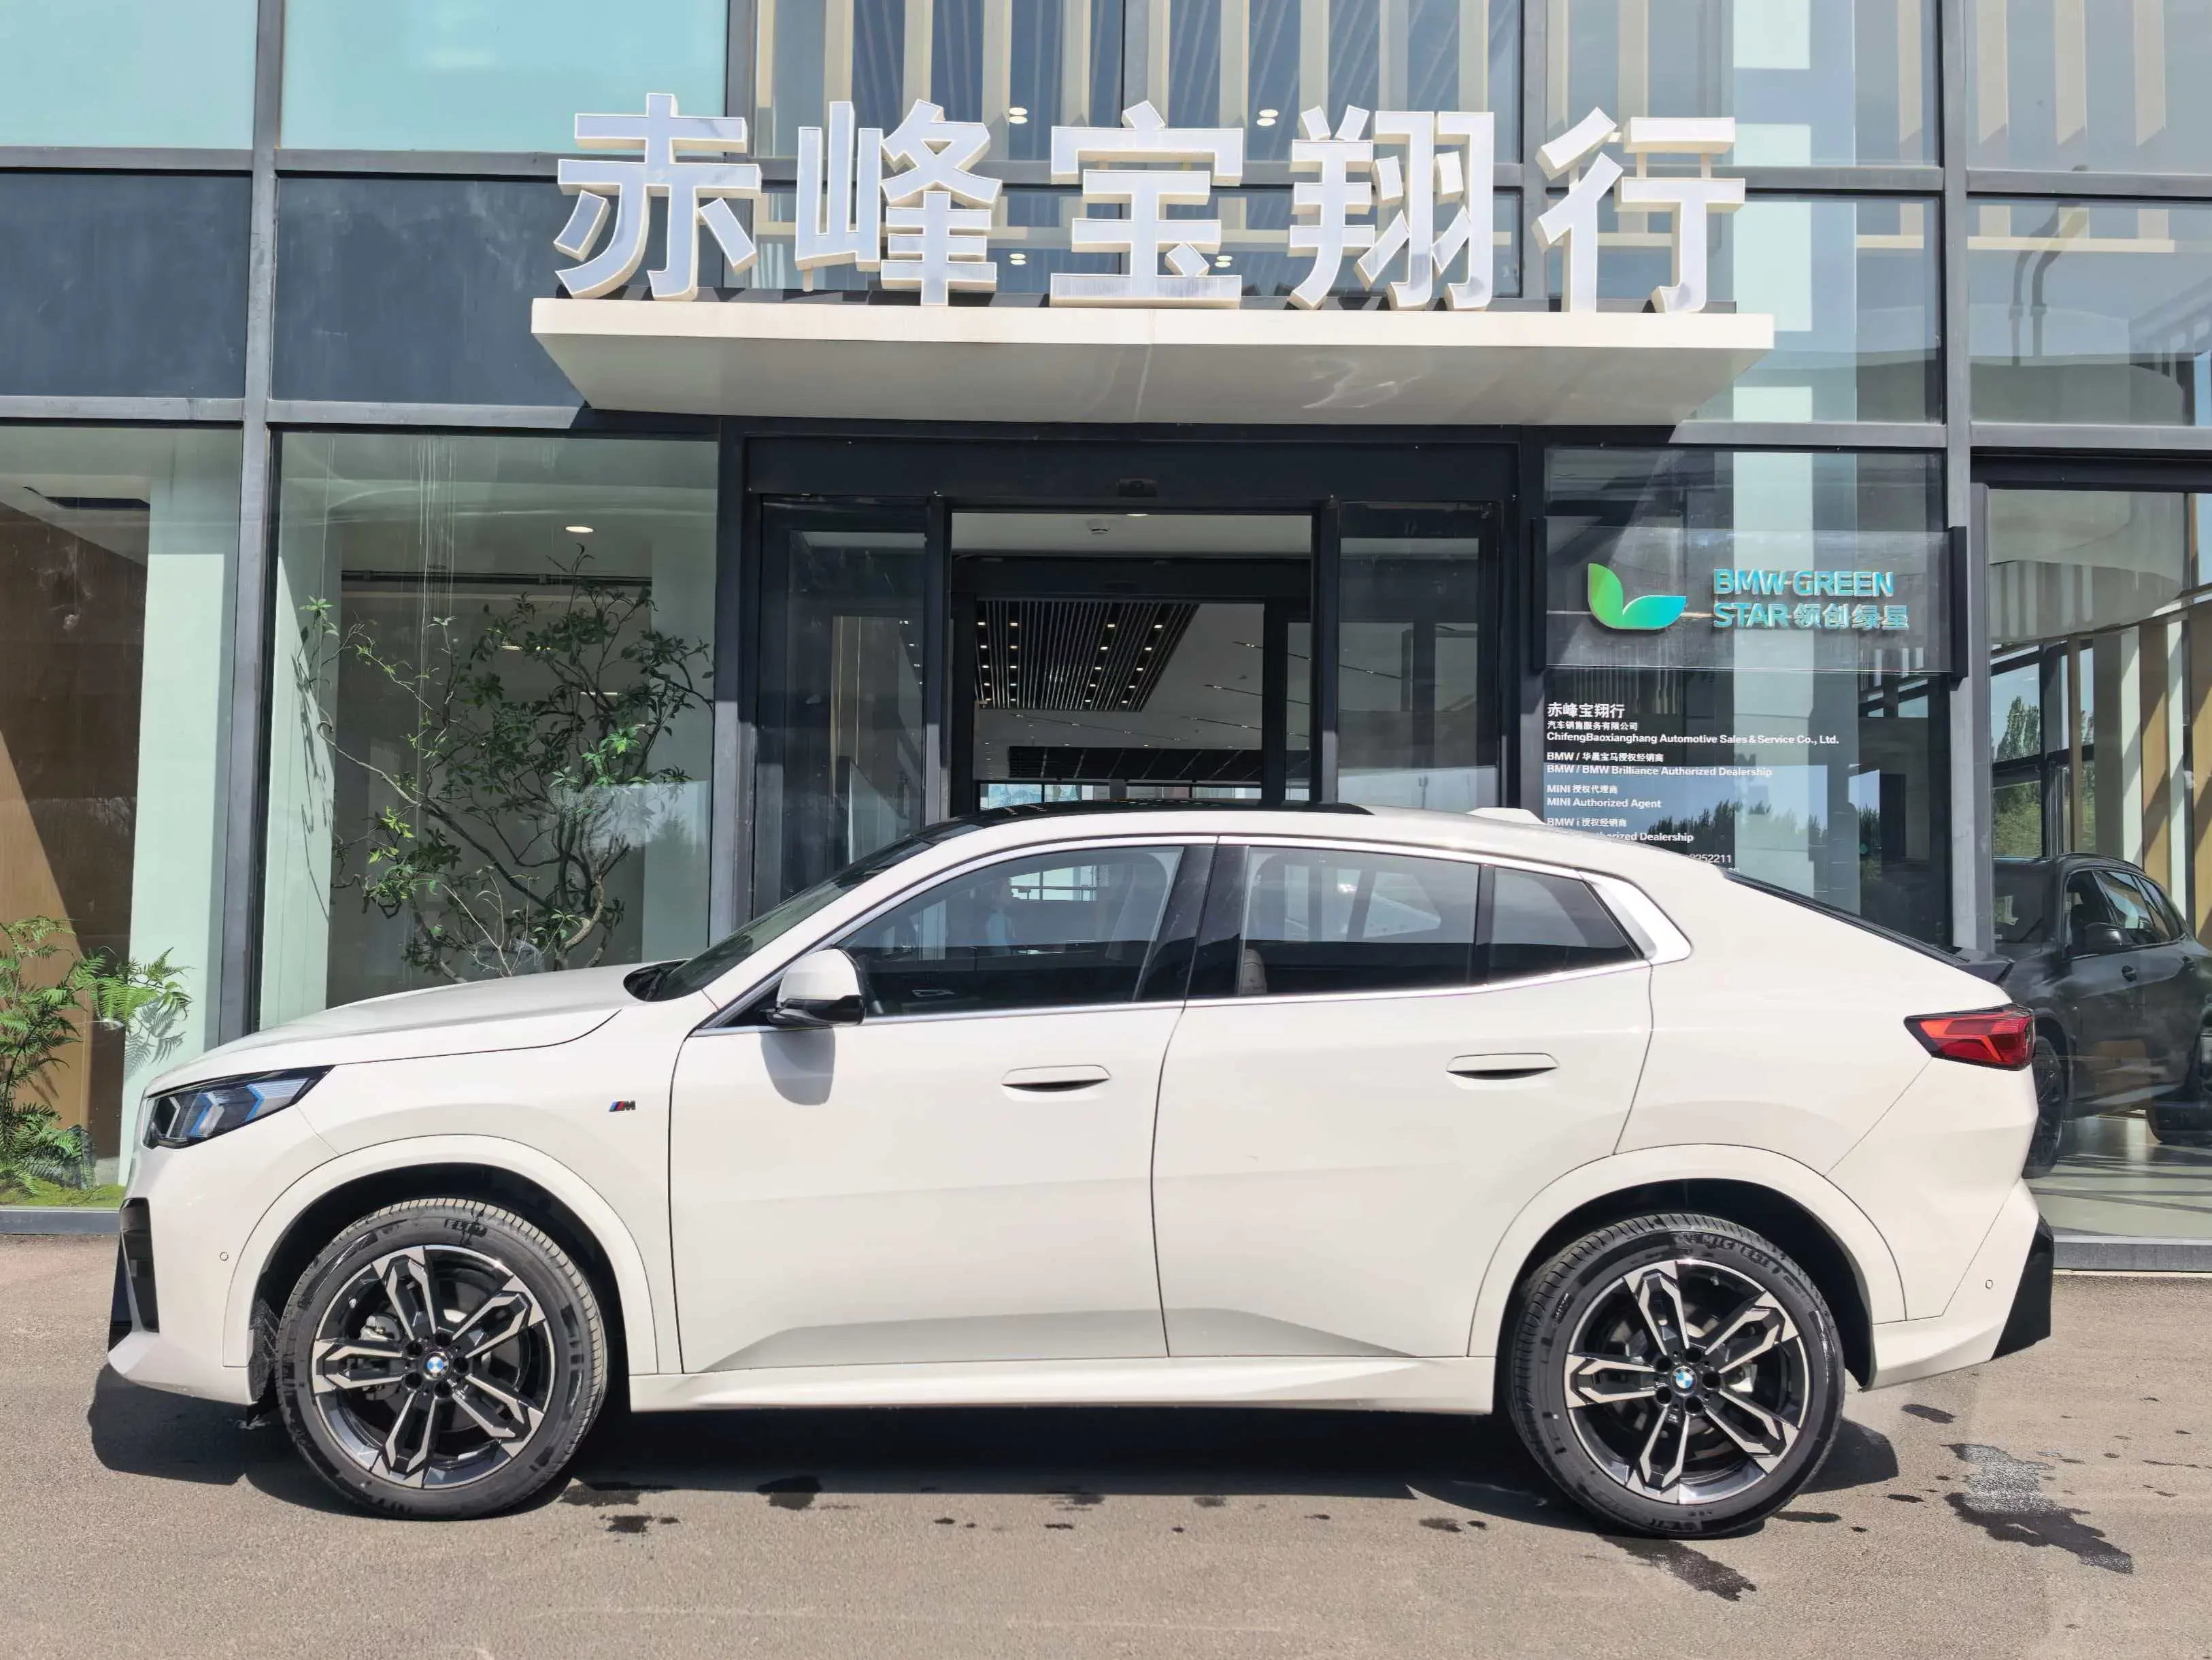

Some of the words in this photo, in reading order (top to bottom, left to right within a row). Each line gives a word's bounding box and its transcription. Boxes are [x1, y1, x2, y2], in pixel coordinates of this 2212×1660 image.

[554, 93, 1746, 314] 赤峰宝翔行
[1713, 569, 1787, 596] BMW
[1792, 570, 1894, 597] GREEN
[1713, 602, 1788, 628] STAR
[1794, 603, 1910, 631] 领创绿星
[1547, 702, 1625, 719] 赤峰宝翔行
[1547, 721, 1638, 731] 汽车销售服务有限公司
[1547, 732, 1657, 744] ChifengBaoxianghang
[1660, 734, 1717, 744] Automotive
[1720, 735, 1748, 744] Sales
[1758, 735, 1795, 744] Service
[1820, 735, 1839, 744] Ltd.
[1547, 752, 1573, 761] BMW
[1582, 752, 1664, 762] 华晨宝马授权经销商
[1547, 765, 1573, 774] BMW
[1582, 765, 1609, 774] BMW
[1611, 766, 1658, 776] Brilliance
[1661, 767, 1716, 776] Authorized
[1719, 767, 1772, 778] Dealership
[1547, 784, 1571, 793] MINI
[1573, 784, 1618, 795] 授权代理商
[1547, 797, 1571, 806] MINI
[1573, 798, 1628, 808] Authorized
[1630, 799, 1662, 810] Agent
[1547, 818, 1573, 827] BMW
[1581, 818, 1627, 828] 授权经销商
[1640, 833, 1694, 843] Dealership
